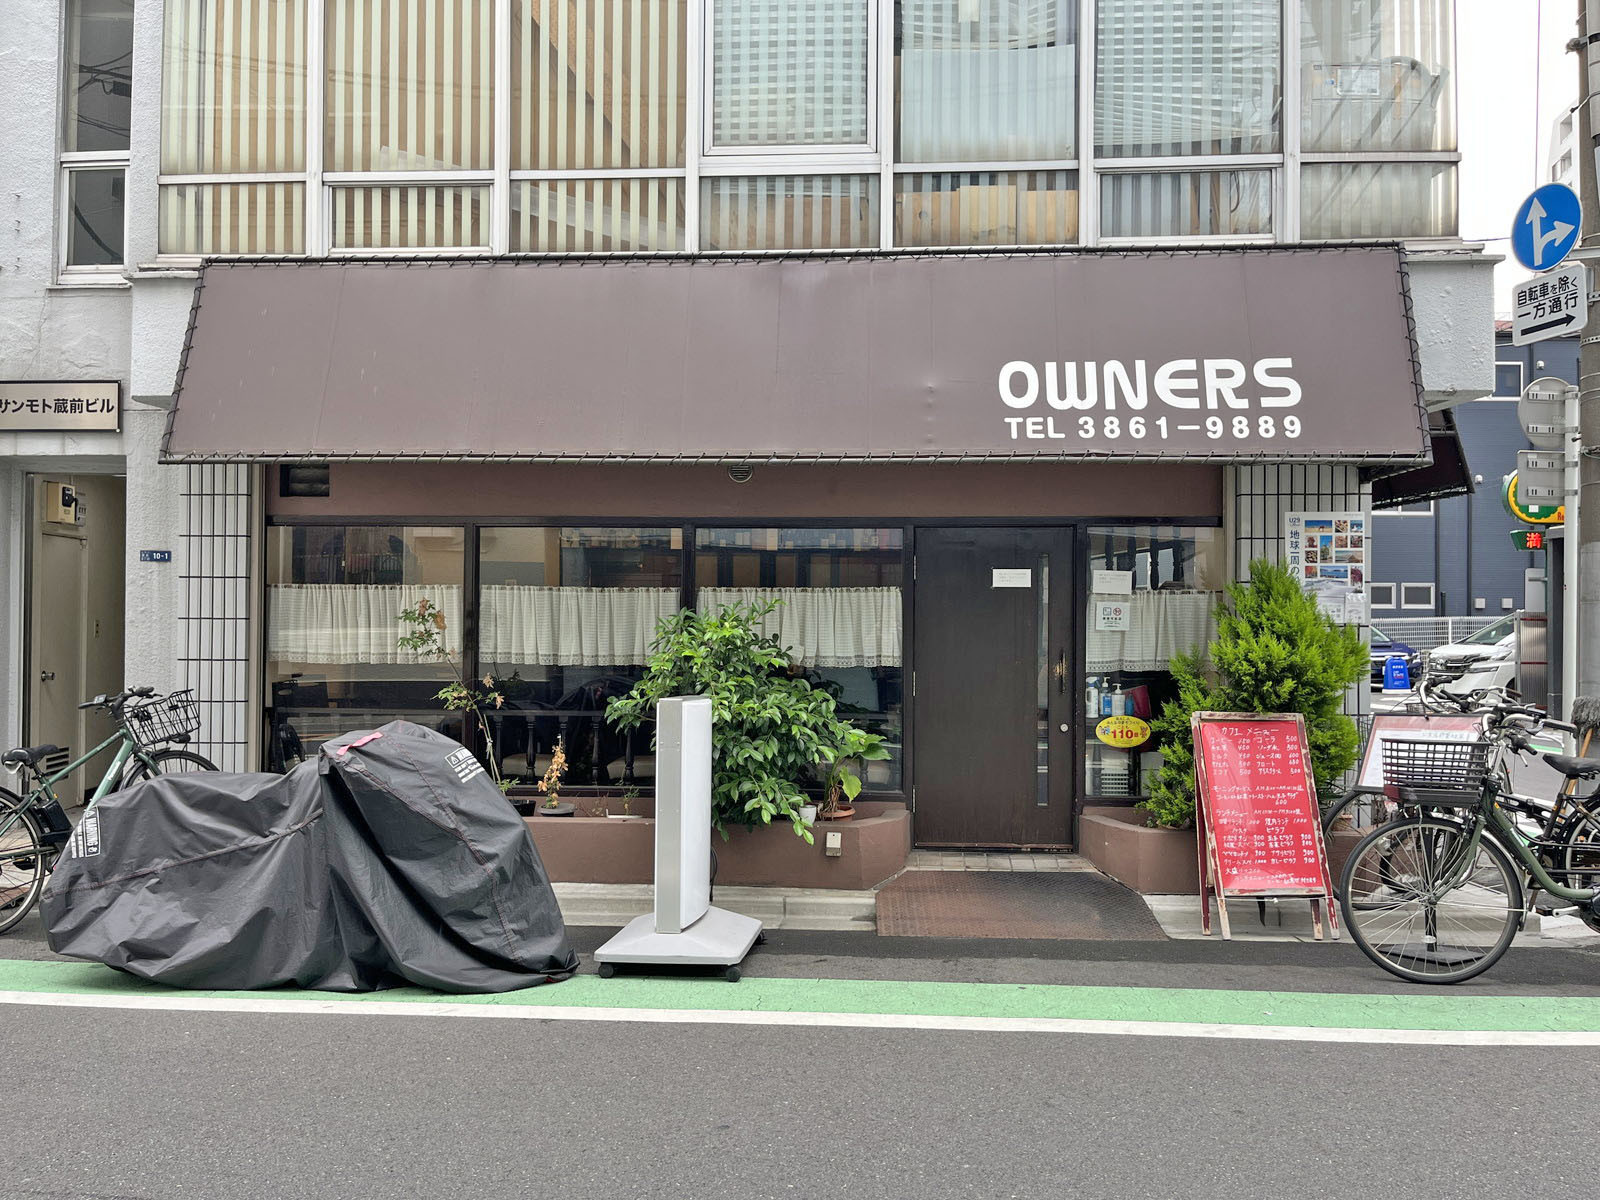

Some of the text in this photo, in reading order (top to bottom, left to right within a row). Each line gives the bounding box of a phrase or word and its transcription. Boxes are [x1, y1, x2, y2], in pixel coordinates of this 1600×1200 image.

[1517, 275, 1578, 306] 自転車を除く
[1517, 292, 1579, 320] 一方通行
[998, 357, 1302, 410] OWNERS
[0, 398, 115, 413] サンモト蔵前ビル
[1003, 417, 1066, 439] TEL
[1526, 532, 1542, 549] 満
[1222, 726, 1242, 736] カフェ
